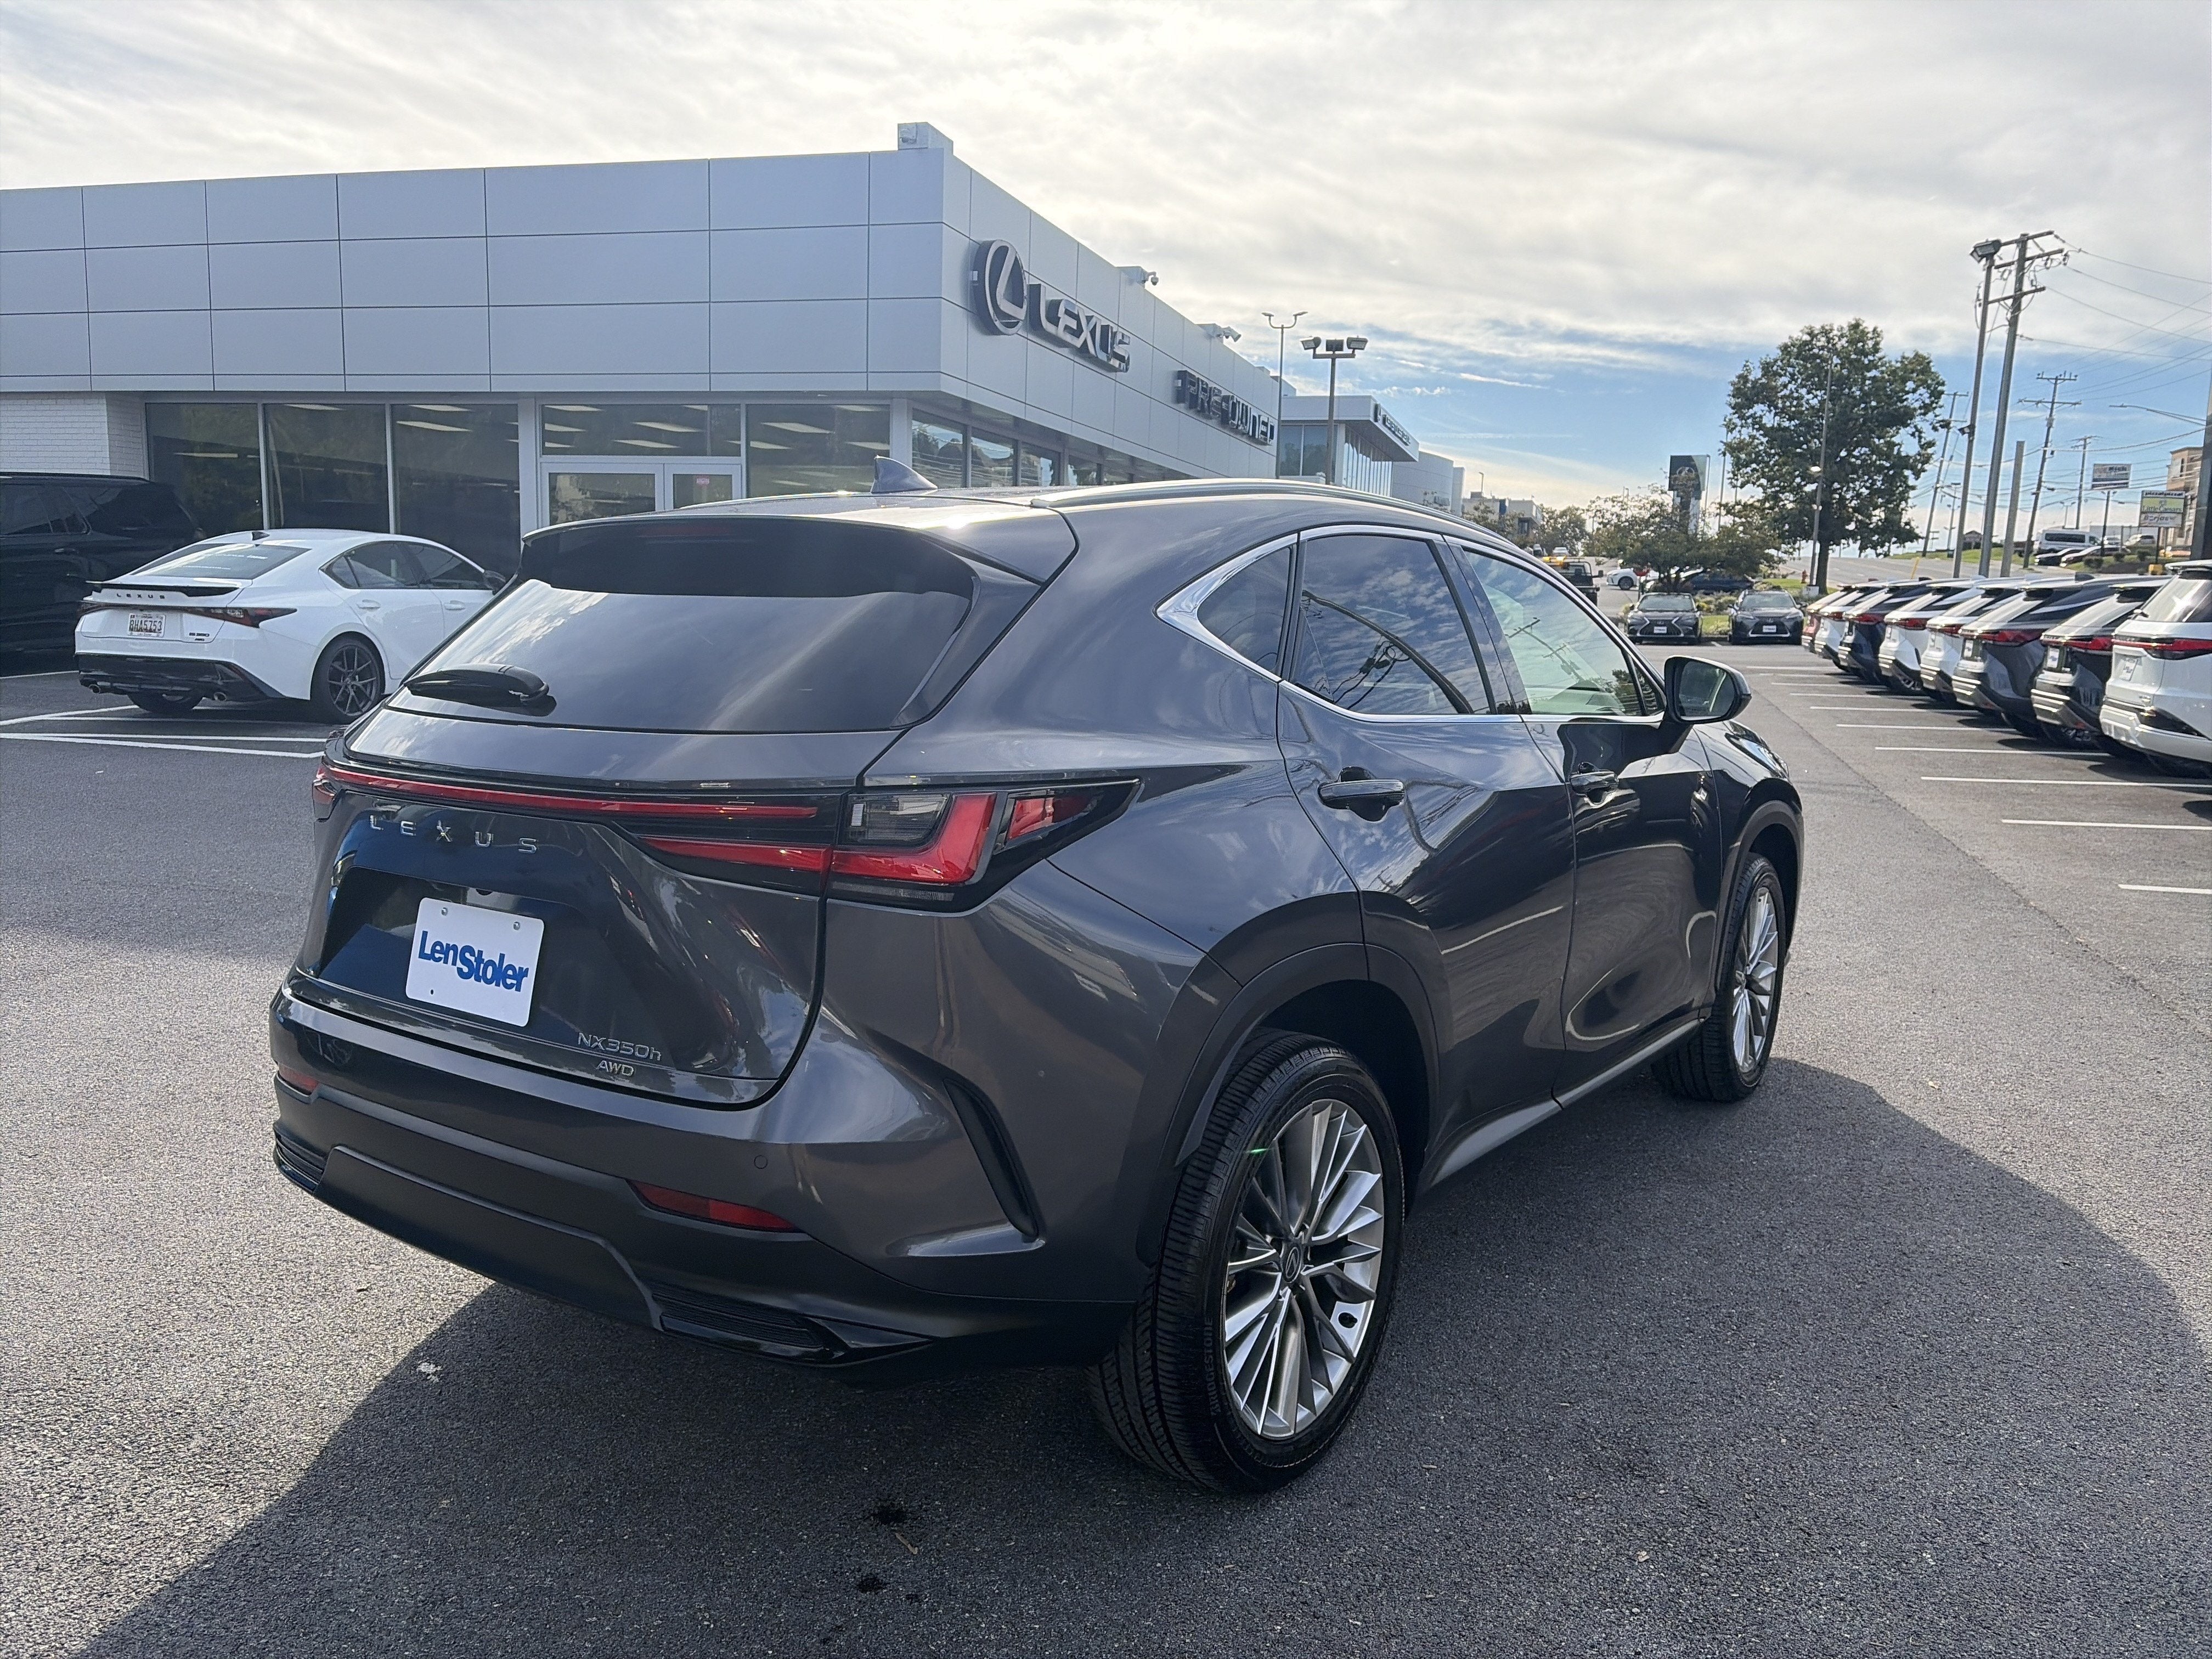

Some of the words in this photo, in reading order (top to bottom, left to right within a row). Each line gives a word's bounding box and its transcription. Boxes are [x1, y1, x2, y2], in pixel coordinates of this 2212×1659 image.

[1029, 284, 1130, 373] LEXUS
[370, 815, 538, 854] LEXUS
[596, 1060, 636, 1077] AWD
